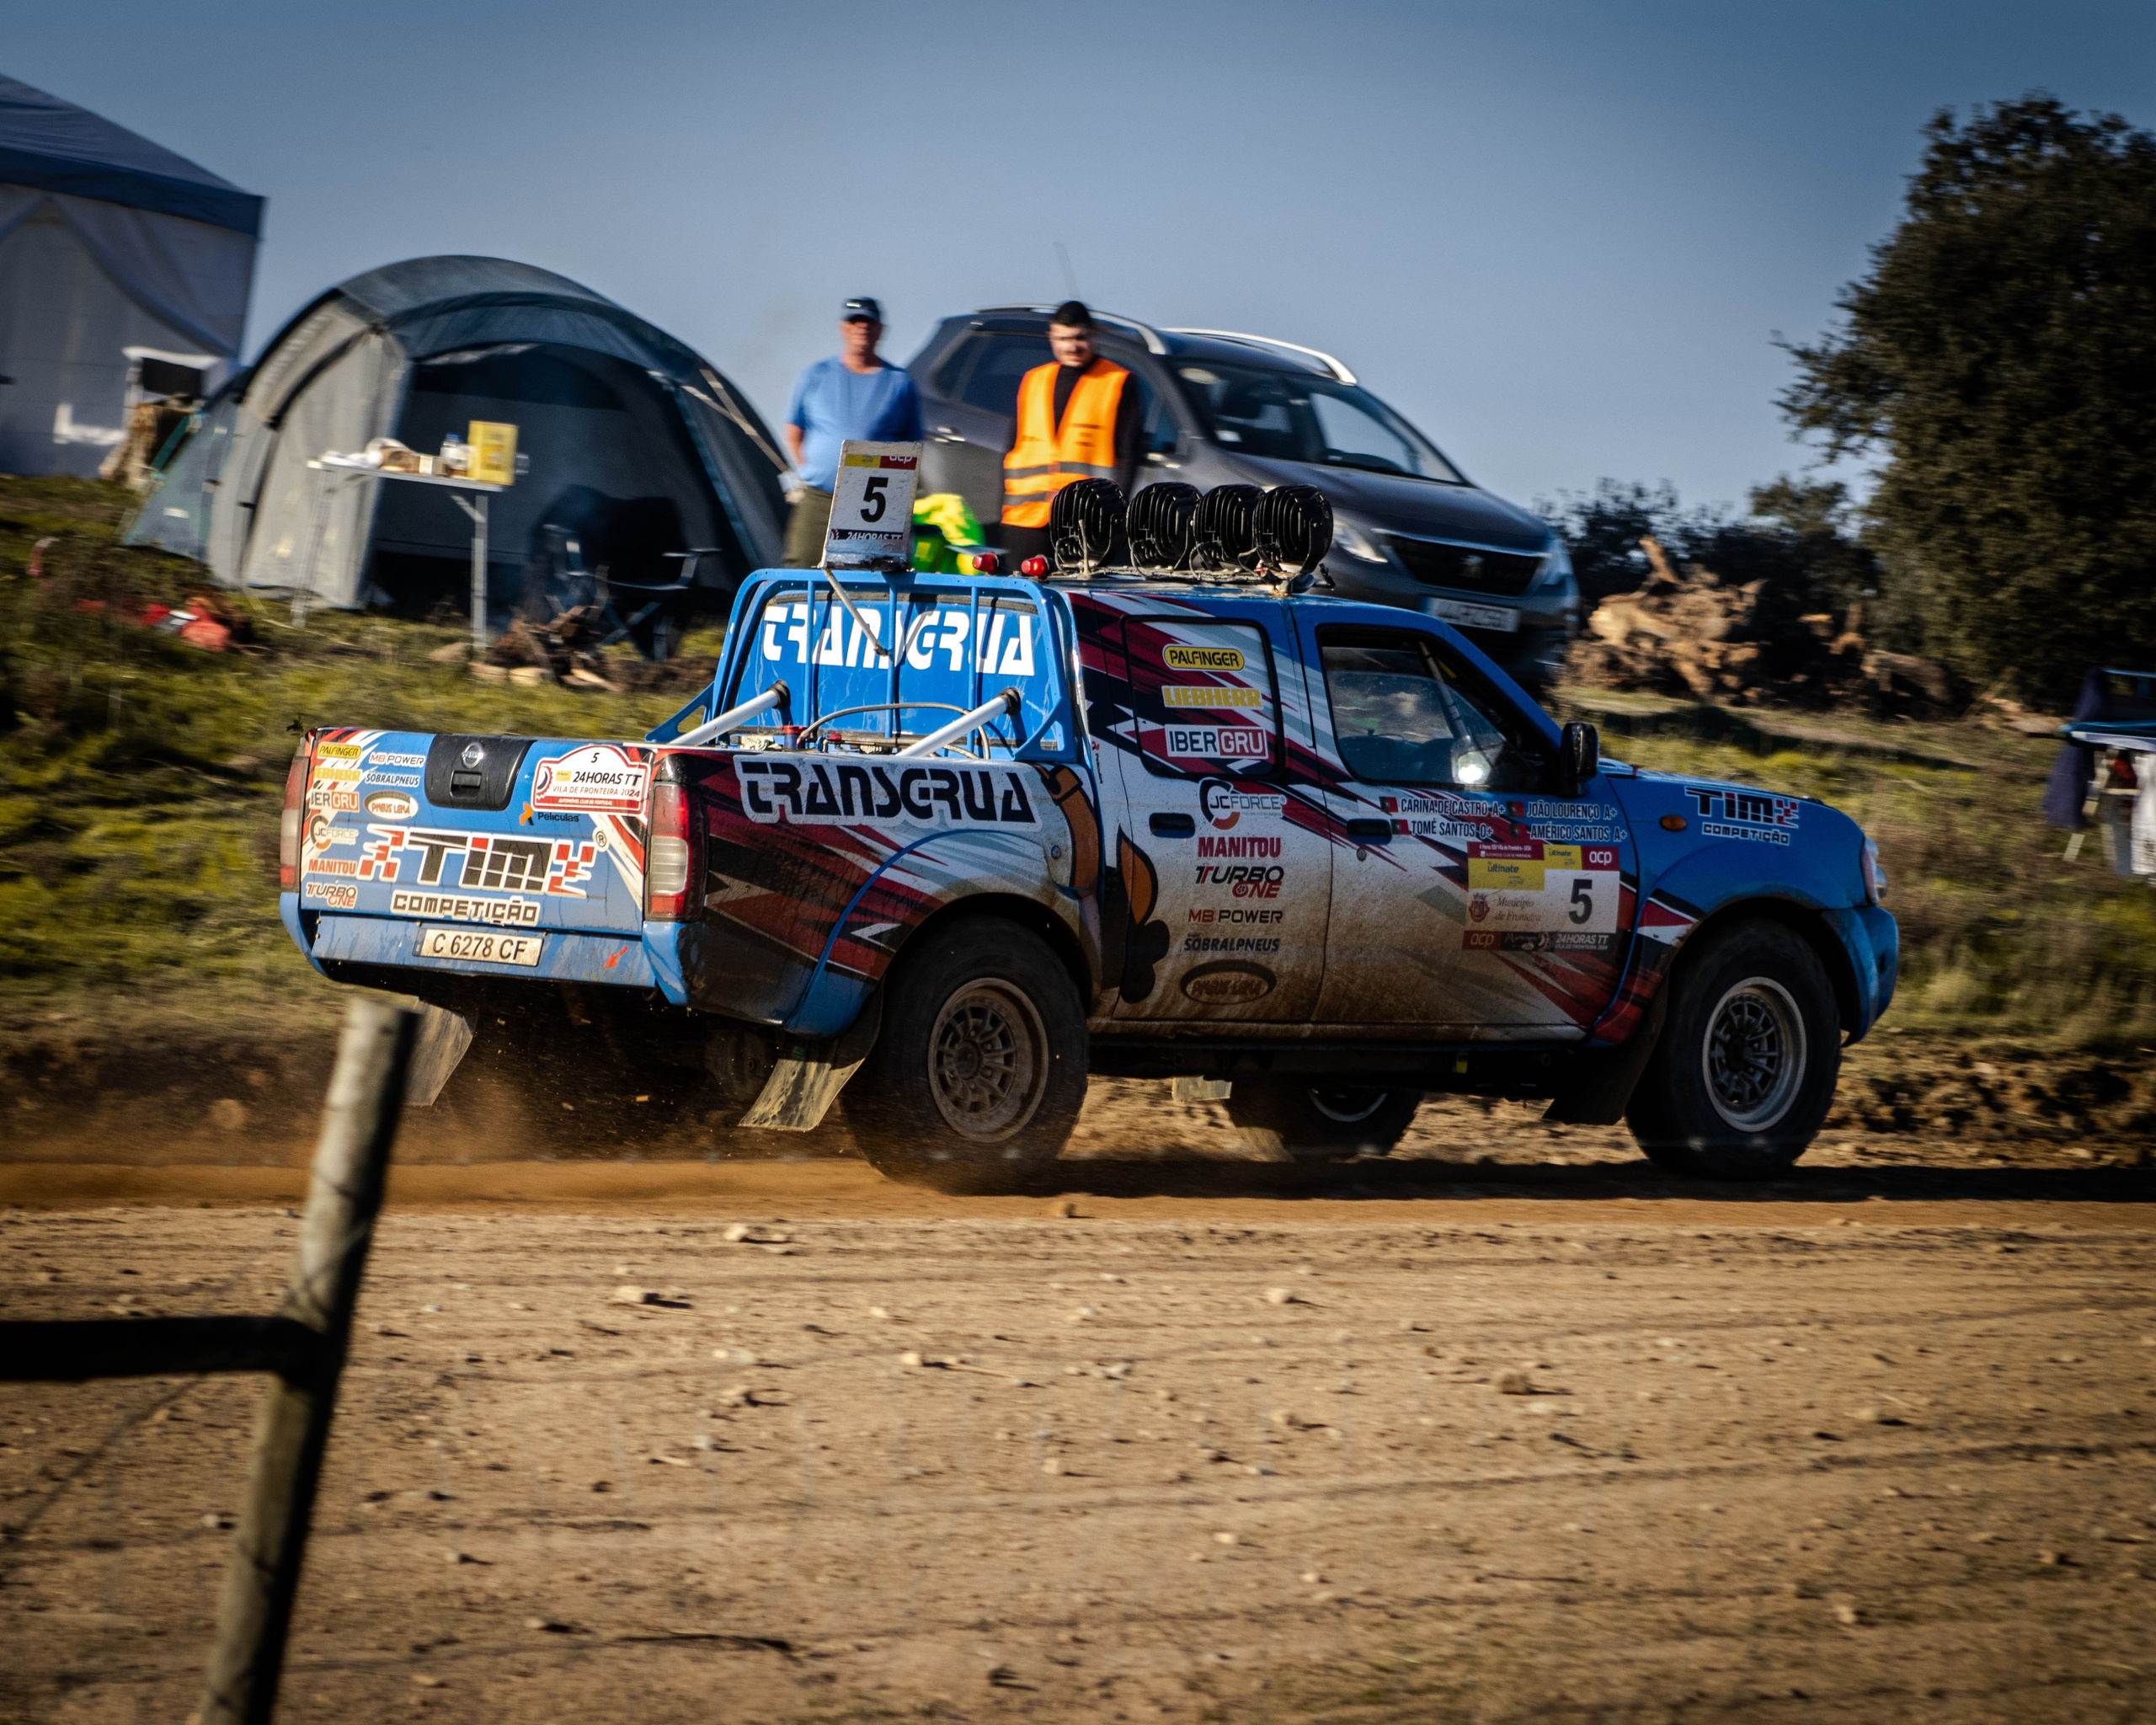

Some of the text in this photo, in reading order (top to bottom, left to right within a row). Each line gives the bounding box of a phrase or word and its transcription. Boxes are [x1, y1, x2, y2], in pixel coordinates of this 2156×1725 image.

[860, 477, 889, 522] 5
[1169, 650, 1240, 666] PALFINGER
[1163, 687, 1262, 708] LIEBHERR
[319, 745, 360, 758] PALFINGER
[370, 754, 424, 766] MB POWER
[591, 752, 600, 763] 5
[366, 772, 419, 786] SOBRALPNEUS
[624, 773, 643, 787] TT
[579, 787, 619, 796] FRONTEIRA
[620, 789, 641, 798] 2024
[741, 761, 1036, 825] TRANSGRUA
[1401, 798, 1506, 817] CARINA DE CASTRO A+
[1526, 799, 1618, 822] JOÃO LOURENÇO A+
[1411, 817, 1437, 836] TOMÉ
[1439, 822, 1476, 837] SANTOS
[1530, 821, 1627, 842] AMÉRICO SANTOS A+
[1703, 823, 1789, 845] COMPETIÇÃO
[1198, 836, 1281, 857] MANITOU
[308, 859, 357, 875] MANITOU
[1589, 851, 1612, 866] acp
[1196, 866, 1284, 884] TURBO
[1232, 881, 1282, 899] ONE
[328, 895, 355, 907] ONE
[393, 894, 538, 925] COMPETIÇÃO
[1568, 879, 1593, 924] 5
[1187, 909, 1283, 924] MB POWER
[432, 933, 446, 953] C
[451, 934, 494, 959] 6278
[499, 937, 528, 960] CF
[1183, 937, 1280, 952] SOBRALPNEUS
[1470, 933, 1495, 947] acp
